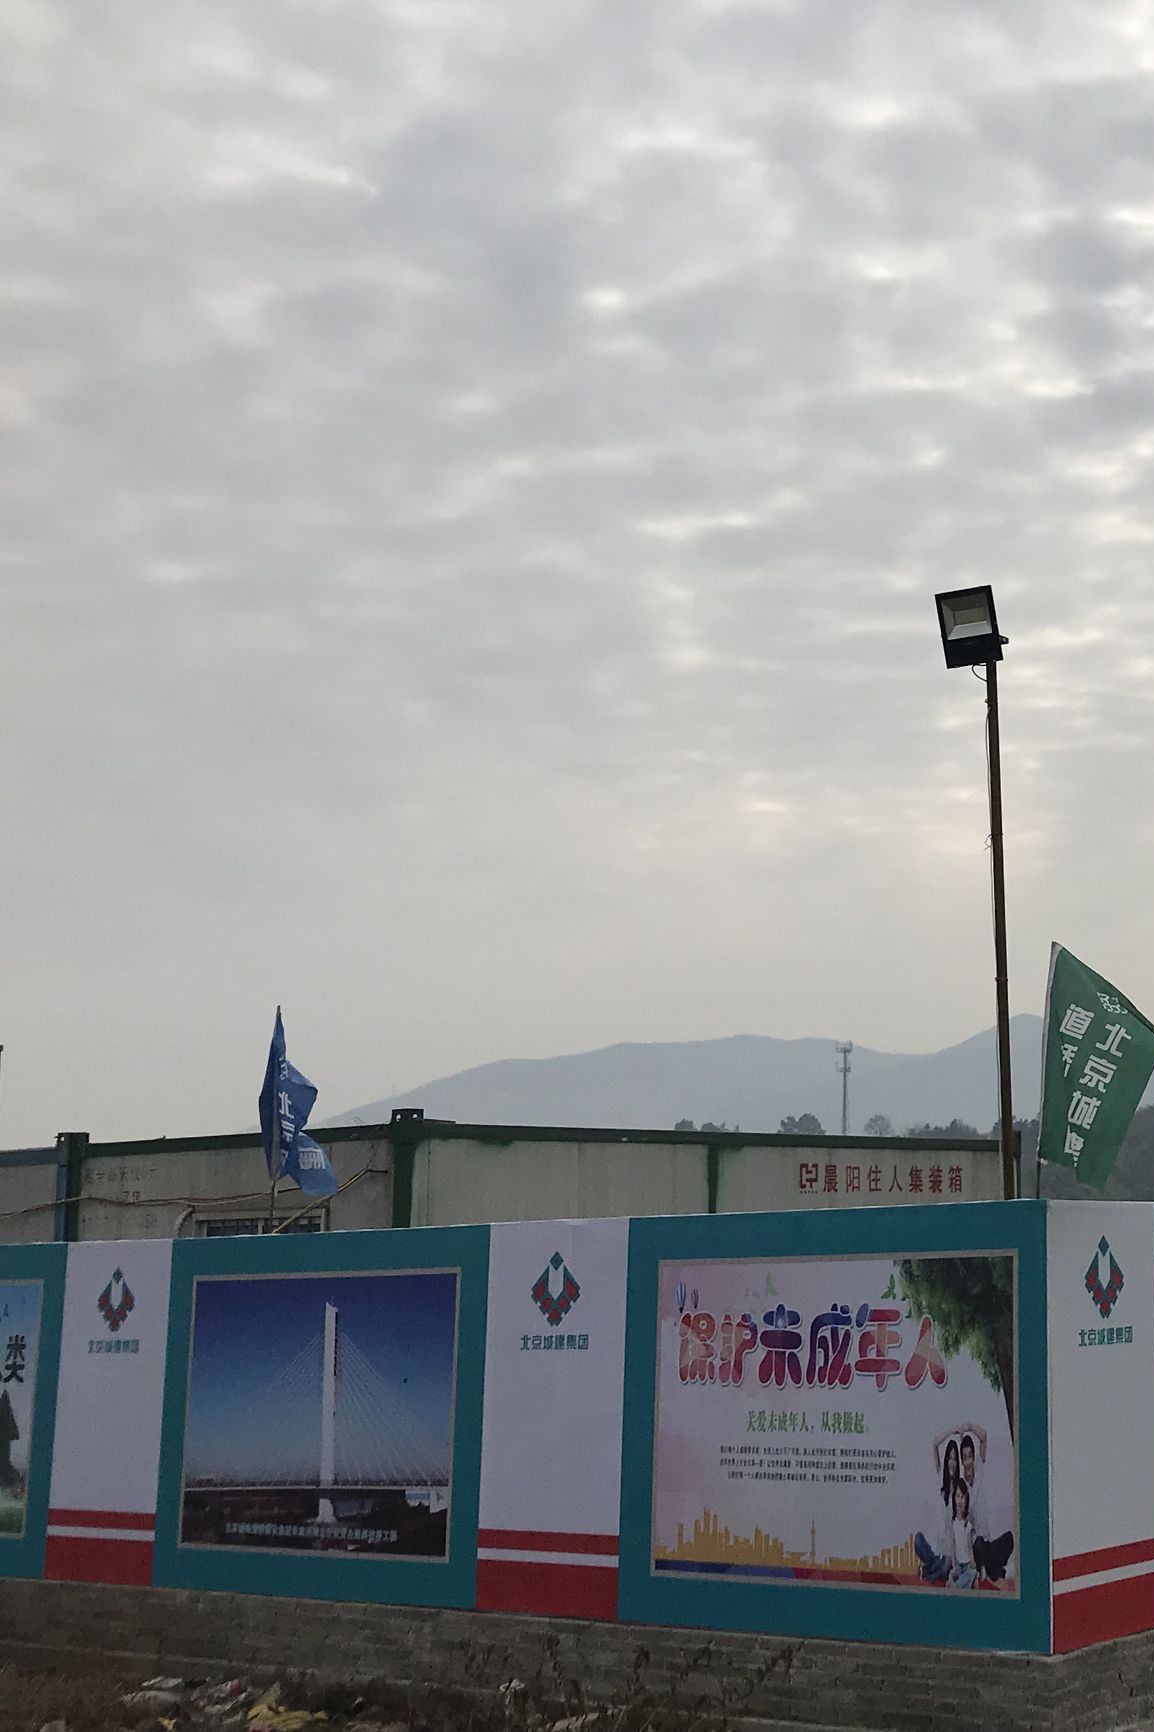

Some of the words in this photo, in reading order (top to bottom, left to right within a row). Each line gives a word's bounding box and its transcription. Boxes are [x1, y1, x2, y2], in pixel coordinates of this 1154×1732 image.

[823, 1164, 963, 1193] 晨阳住人集装箱
[520, 1334, 589, 1350] 北京城建集团
[678, 1303, 947, 1391] 保护未成年人
[1078, 1326, 1132, 1346] 北京城建集团
[0, 1334, 26, 1383] 类
